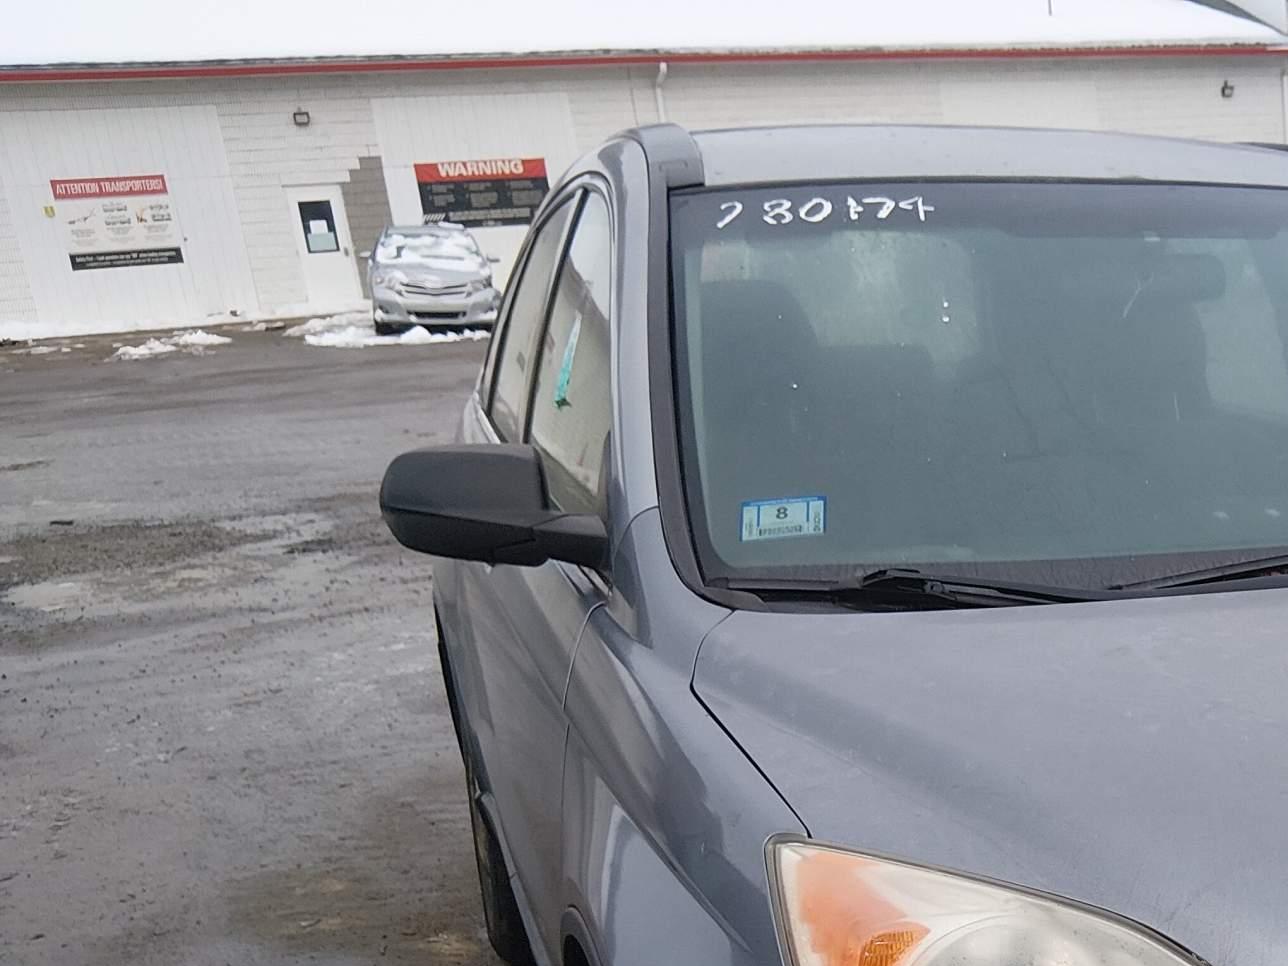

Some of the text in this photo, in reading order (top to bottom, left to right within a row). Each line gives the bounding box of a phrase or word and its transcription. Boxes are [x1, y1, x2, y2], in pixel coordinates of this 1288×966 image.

[438, 160, 524, 177] WARNING
[56, 179, 163, 195] ATTENTION TRANSPORTERS!
[776, 506, 788, 520] 8
